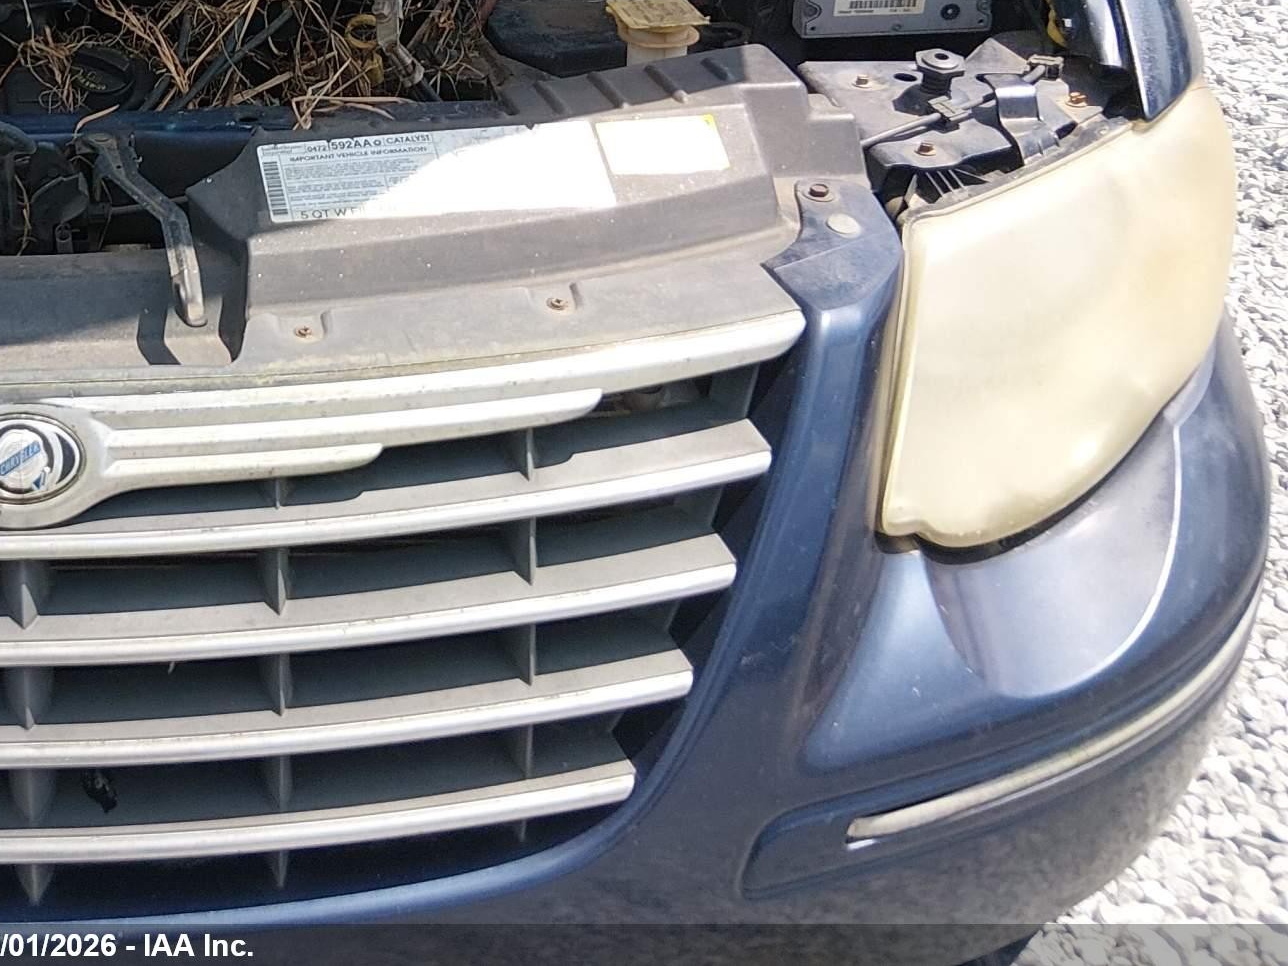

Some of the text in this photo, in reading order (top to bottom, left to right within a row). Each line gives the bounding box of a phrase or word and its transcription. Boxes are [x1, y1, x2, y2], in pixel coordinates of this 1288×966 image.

[385, 134, 431, 144] CATALYST
[290, 146, 427, 162] IMPORTANT VEHICLE INFORMATION
[300, 210, 309, 219] 5
[312, 208, 328, 218] QT
